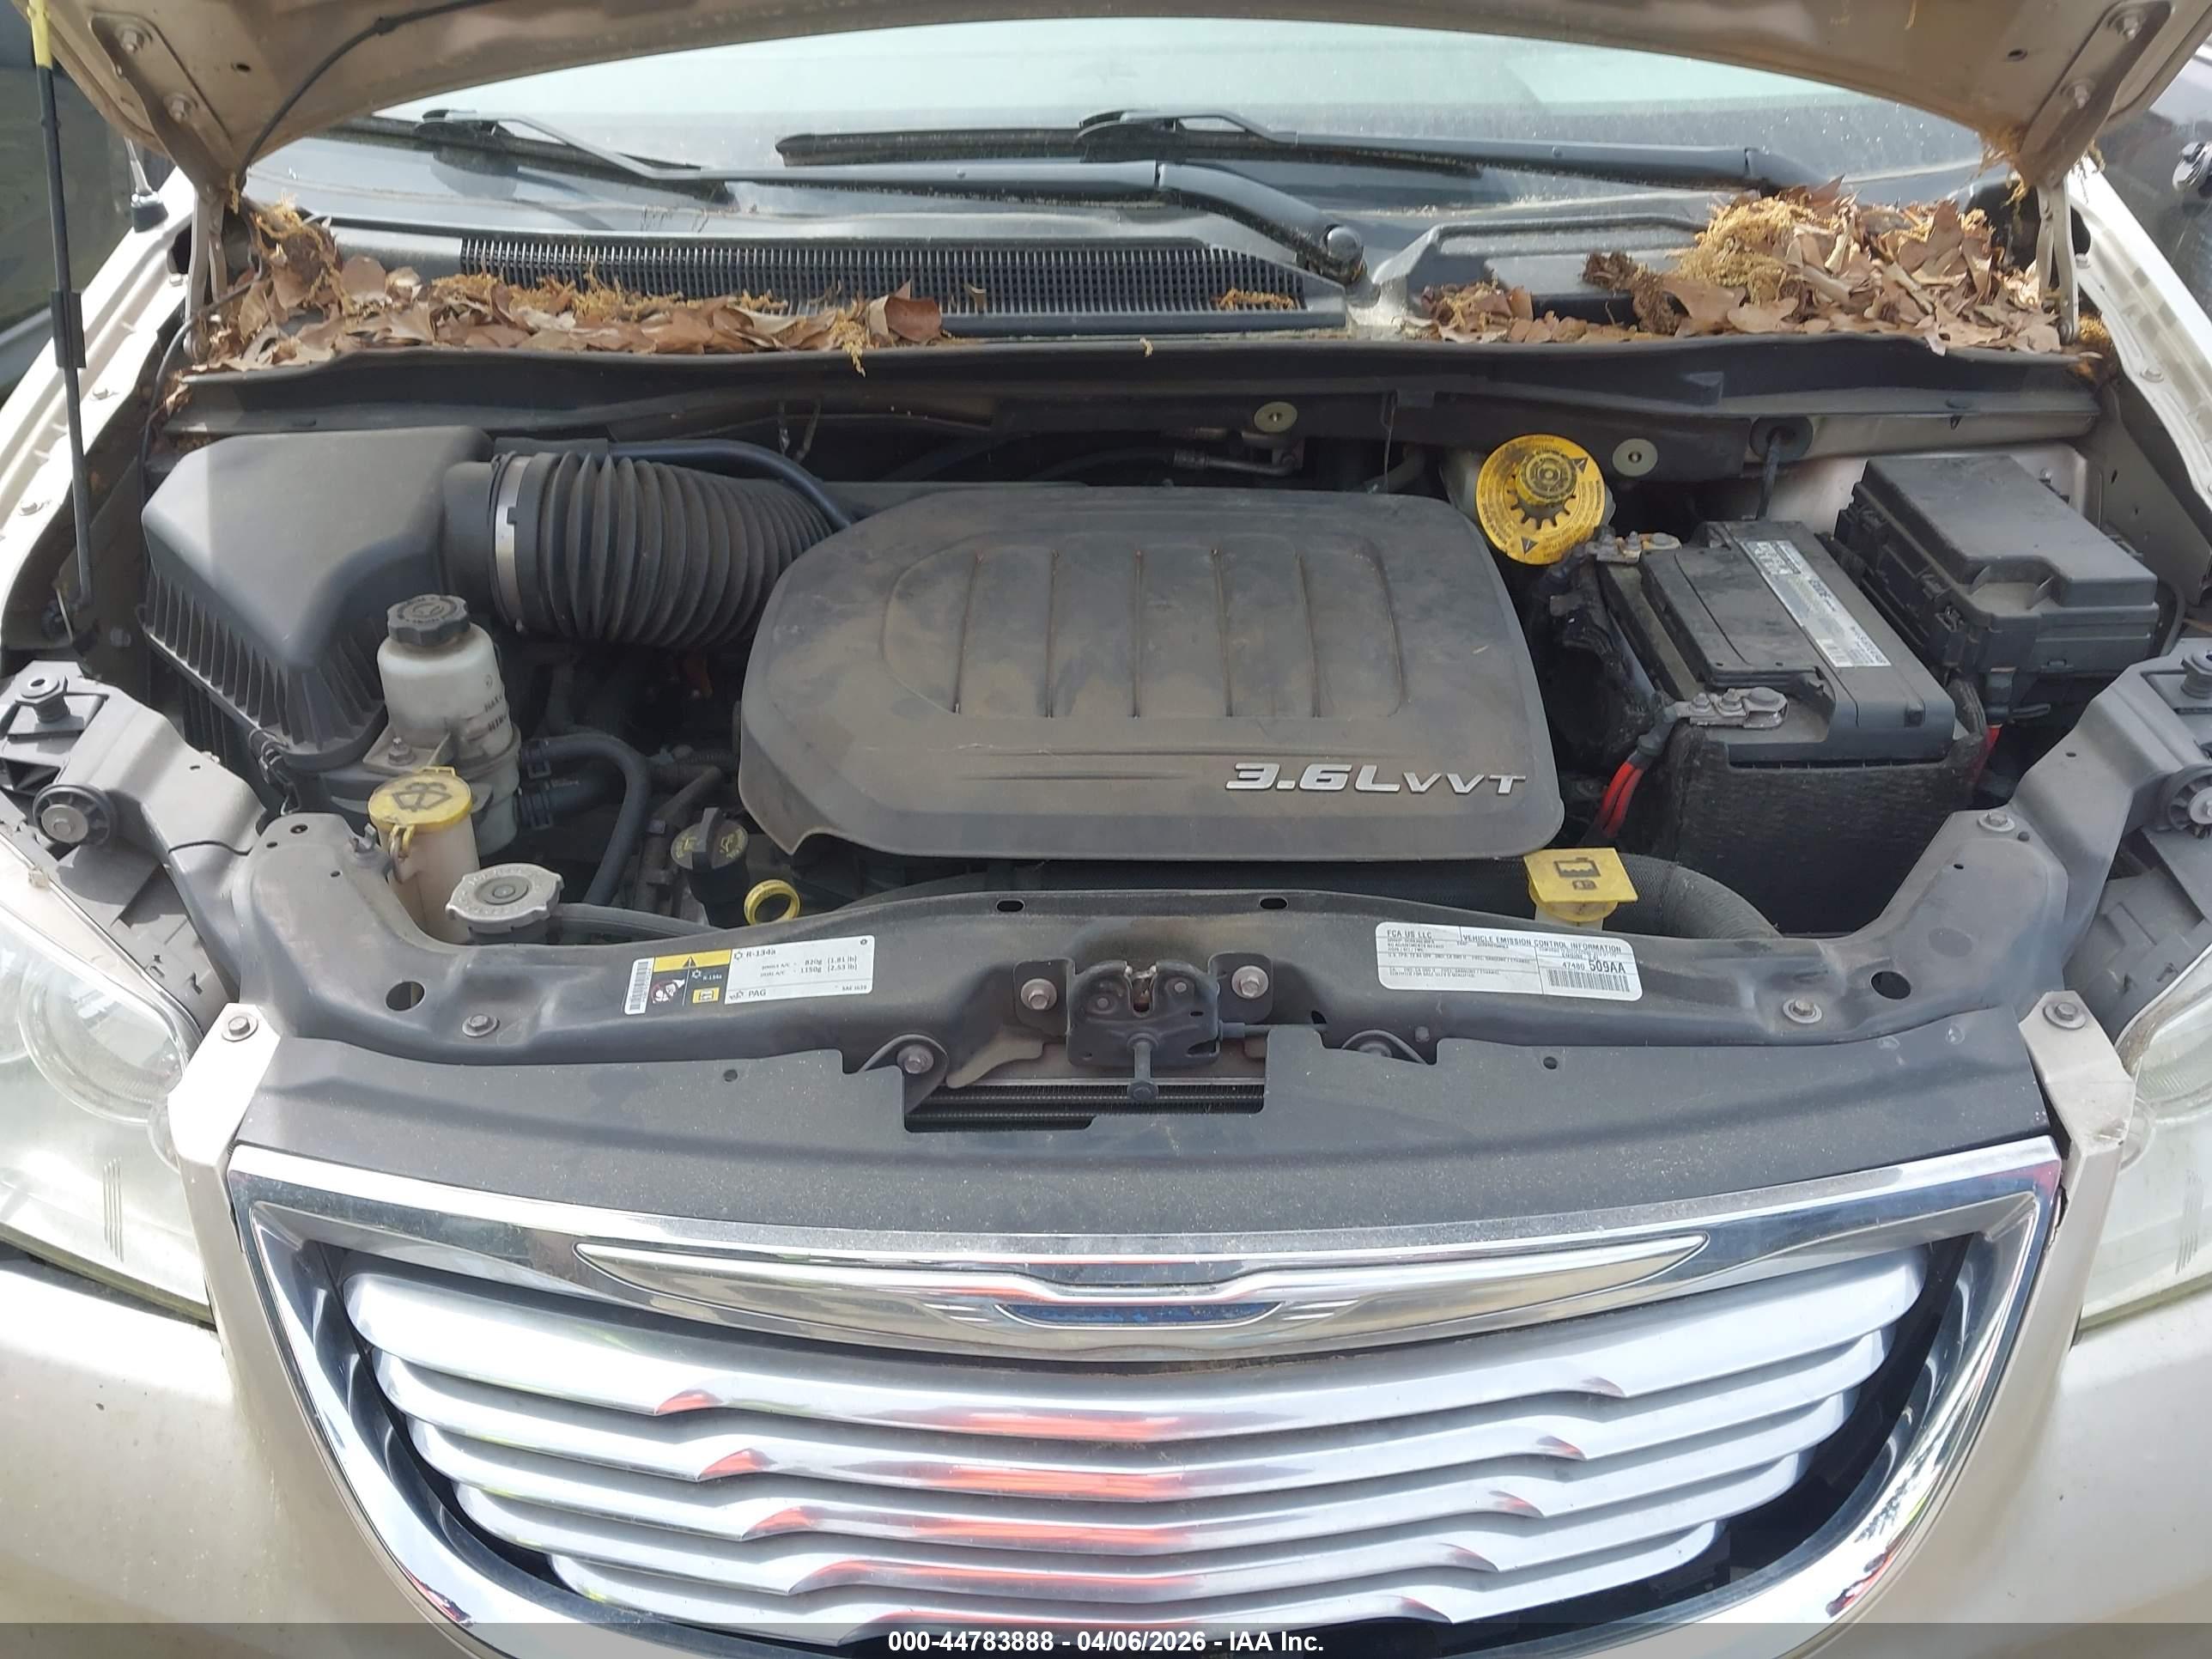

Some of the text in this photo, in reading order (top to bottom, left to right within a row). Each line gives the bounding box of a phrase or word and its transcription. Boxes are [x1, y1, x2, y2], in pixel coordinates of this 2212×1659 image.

[1225, 763, 1527, 794] 3.6L VVT
[1387, 929, 1402, 938] FCA
[1404, 930, 1415, 939] US
[1462, 933, 1493, 943] VEHICLE
[1496, 936, 1532, 946] EMISSION
[1534, 939, 1567, 949] CONTROL
[1570, 942, 1622, 953] INFORMATION
[1589, 959, 1626, 975] 509AA
[748, 988, 767, 998] PAG
